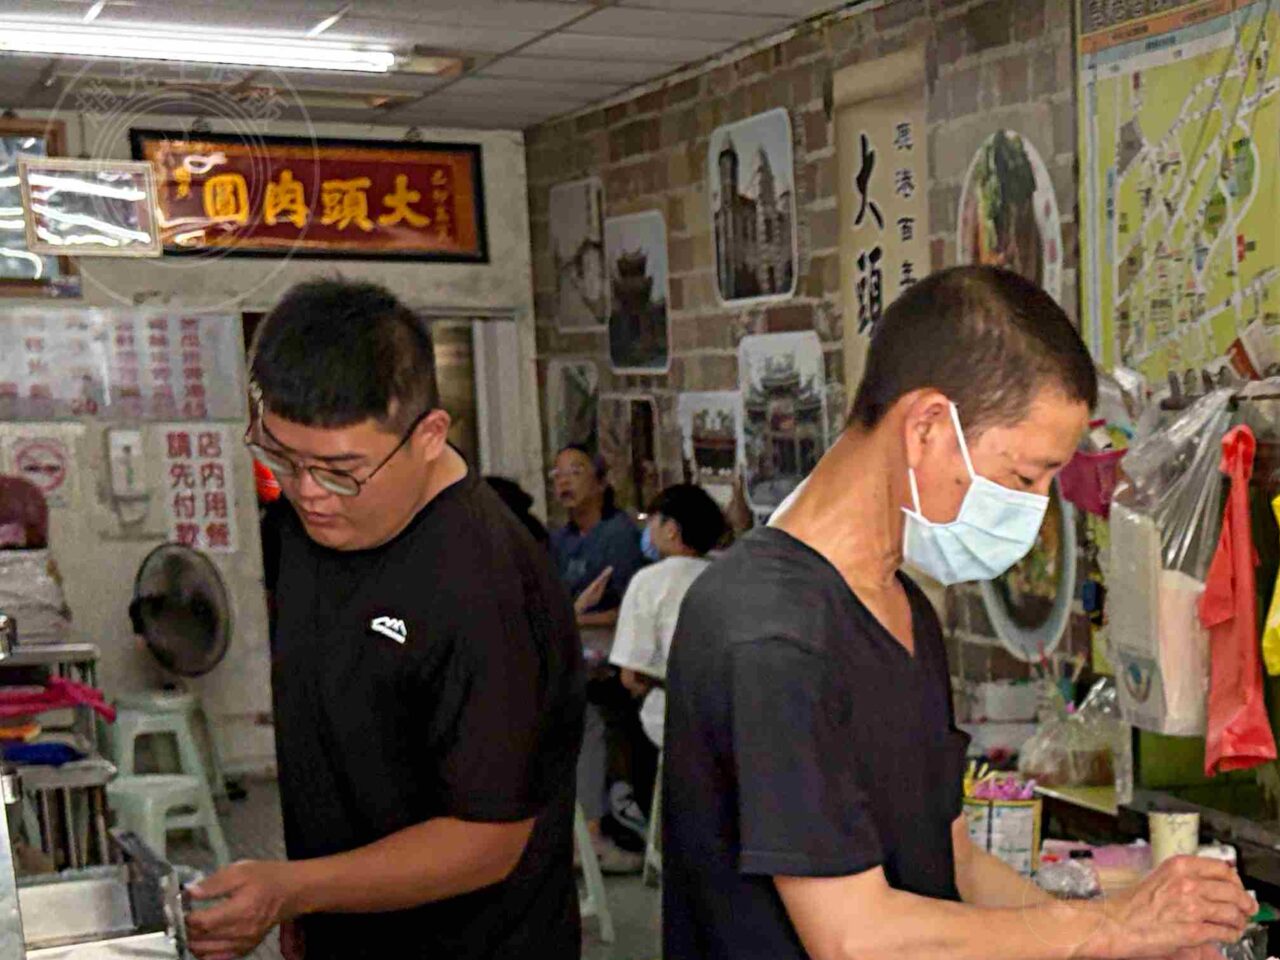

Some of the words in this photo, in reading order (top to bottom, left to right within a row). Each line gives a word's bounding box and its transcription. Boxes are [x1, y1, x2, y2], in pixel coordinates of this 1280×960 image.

[202, 169, 431, 232] 大頭肉圓
[167, 431, 200, 546] 請先付款
[198, 431, 229, 547] 店內用餐
